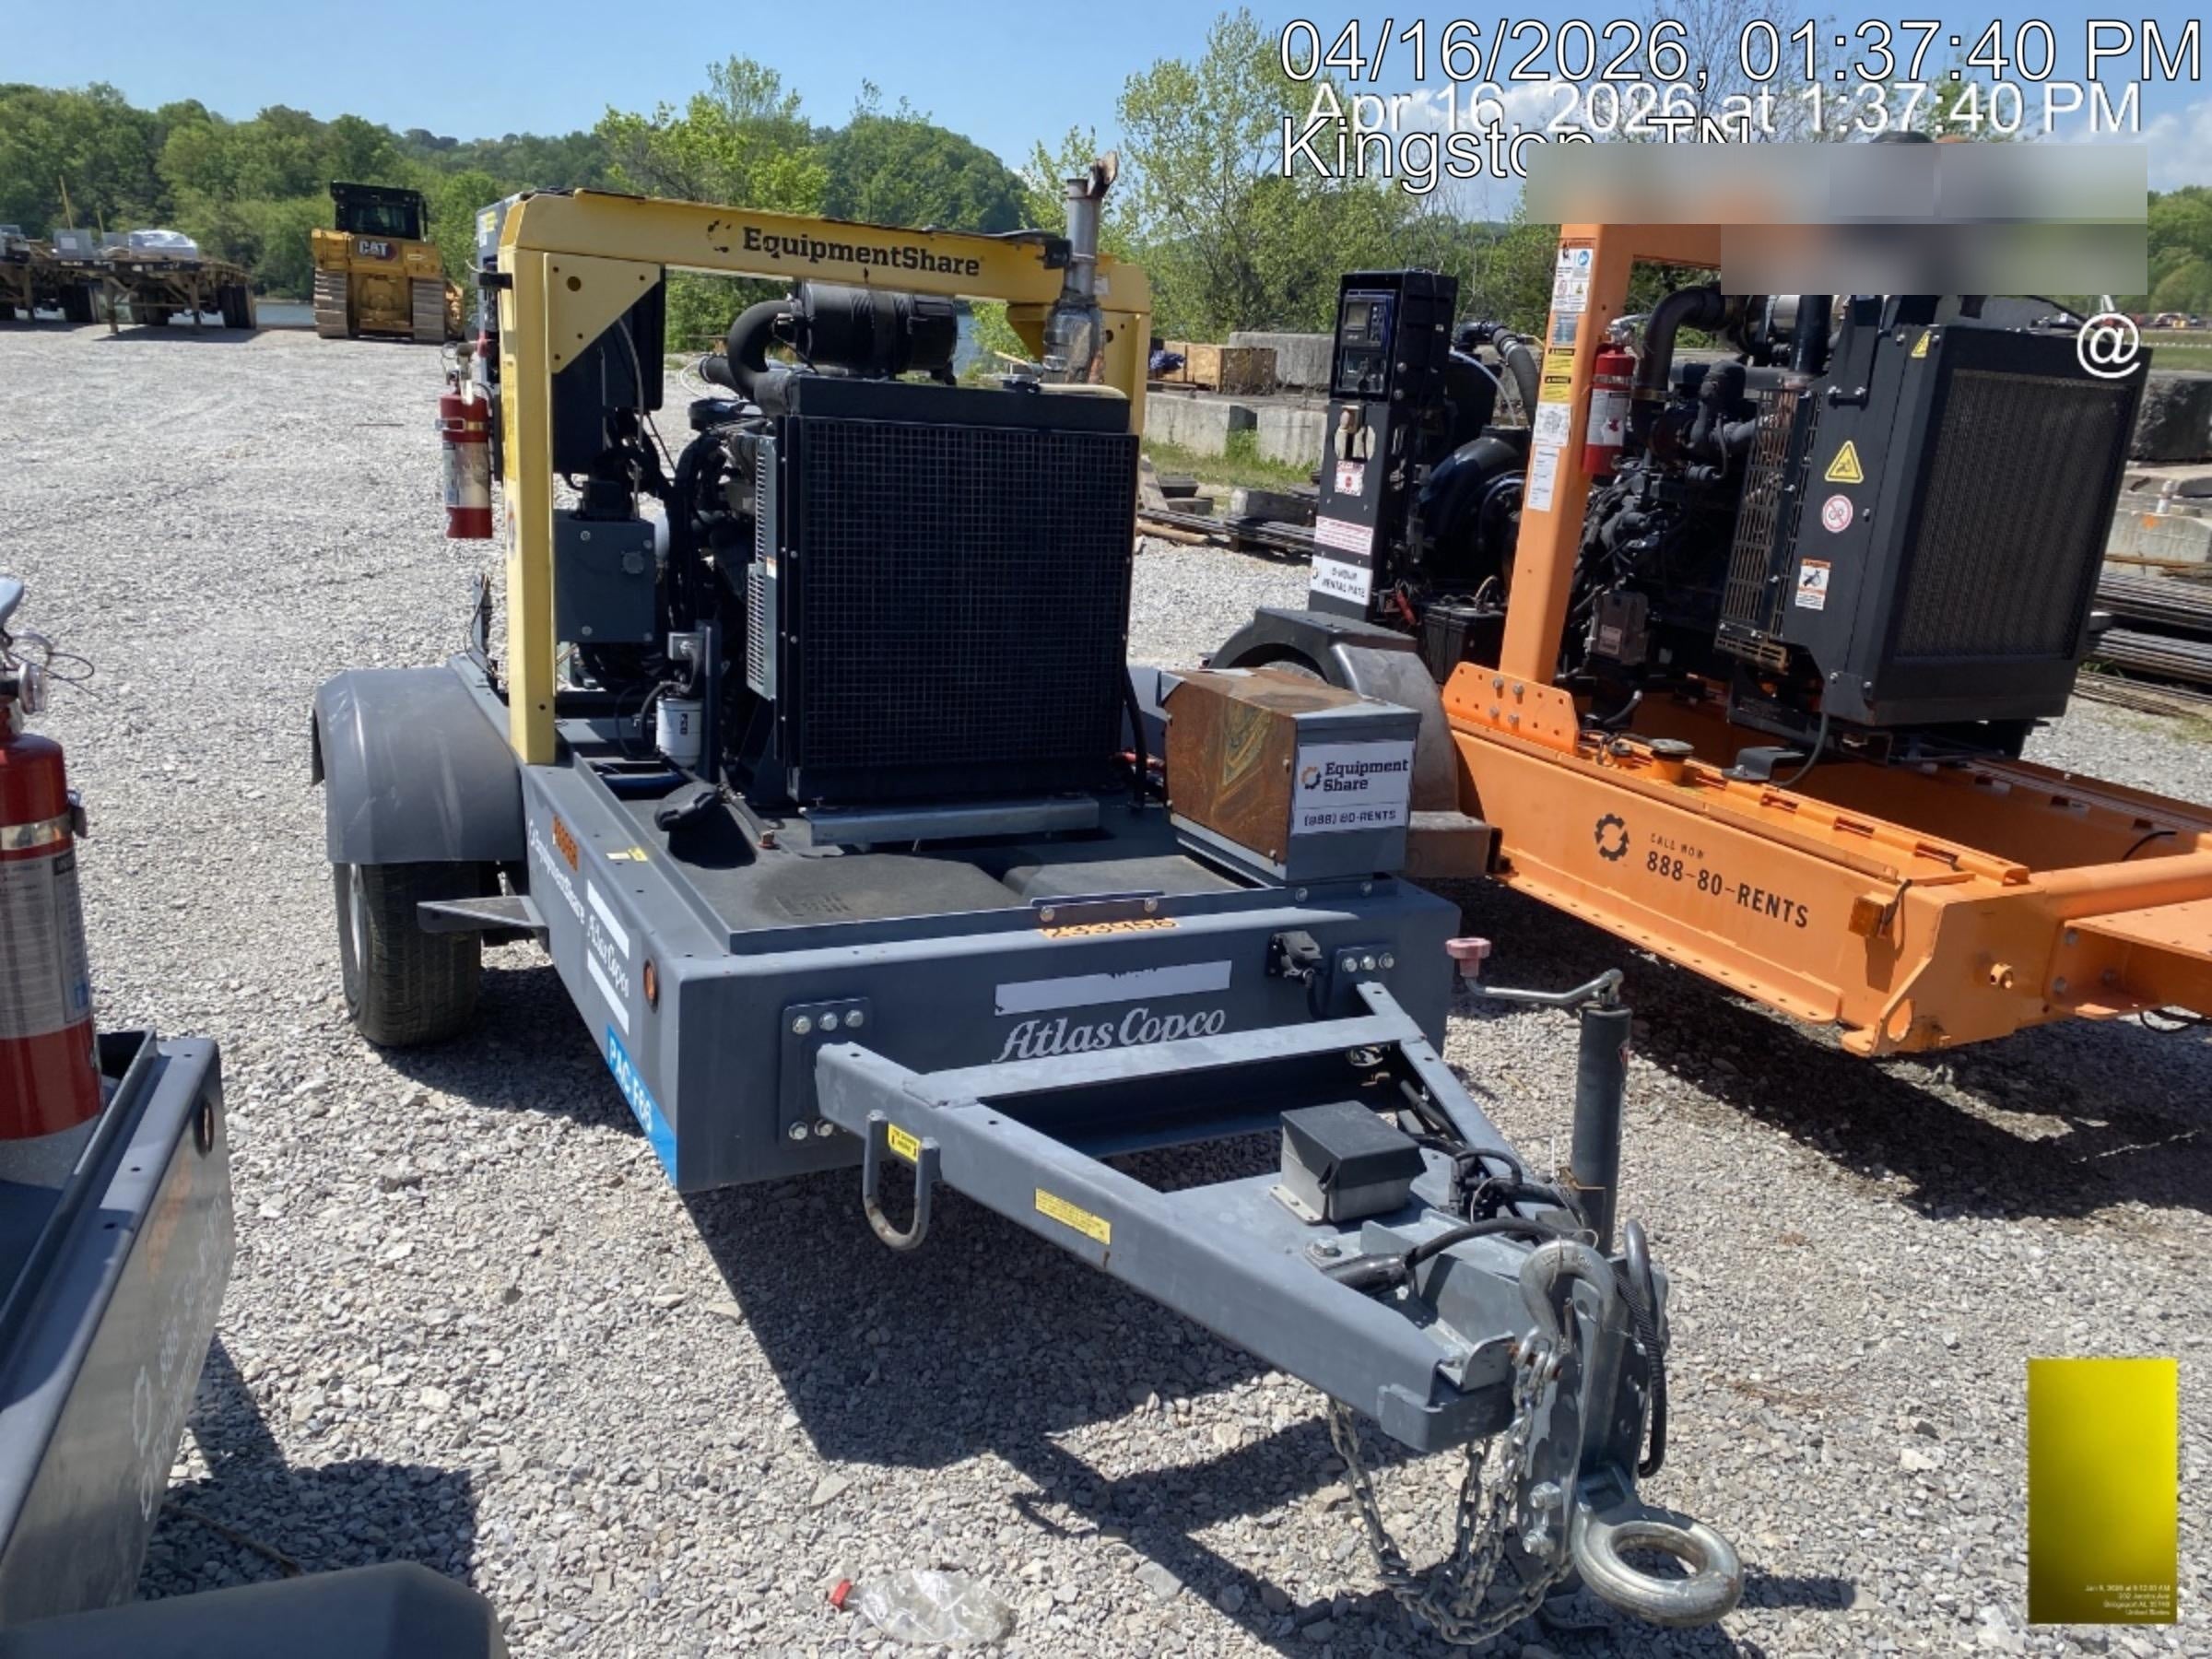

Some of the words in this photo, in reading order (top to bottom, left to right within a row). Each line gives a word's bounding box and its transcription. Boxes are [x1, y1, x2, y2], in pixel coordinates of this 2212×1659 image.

[359, 240, 388, 257] CAT
[743, 227, 980, 276] EquipmentShare
[1324, 759, 1409, 779] Equipment
[1323, 778, 1370, 793] Share
[1304, 814, 1336, 826] (888)
[1339, 810, 1397, 823] 80-RENTS
[1651, 832, 1676, 850] CALL
[1681, 843, 1704, 860] NOW
[1647, 851, 1809, 929] 888-80-RENTS
[992, 1018, 1113, 1064] Atlas
[1118, 1007, 1226, 1048] Copco
[609, 1034, 631, 1094] PAC
